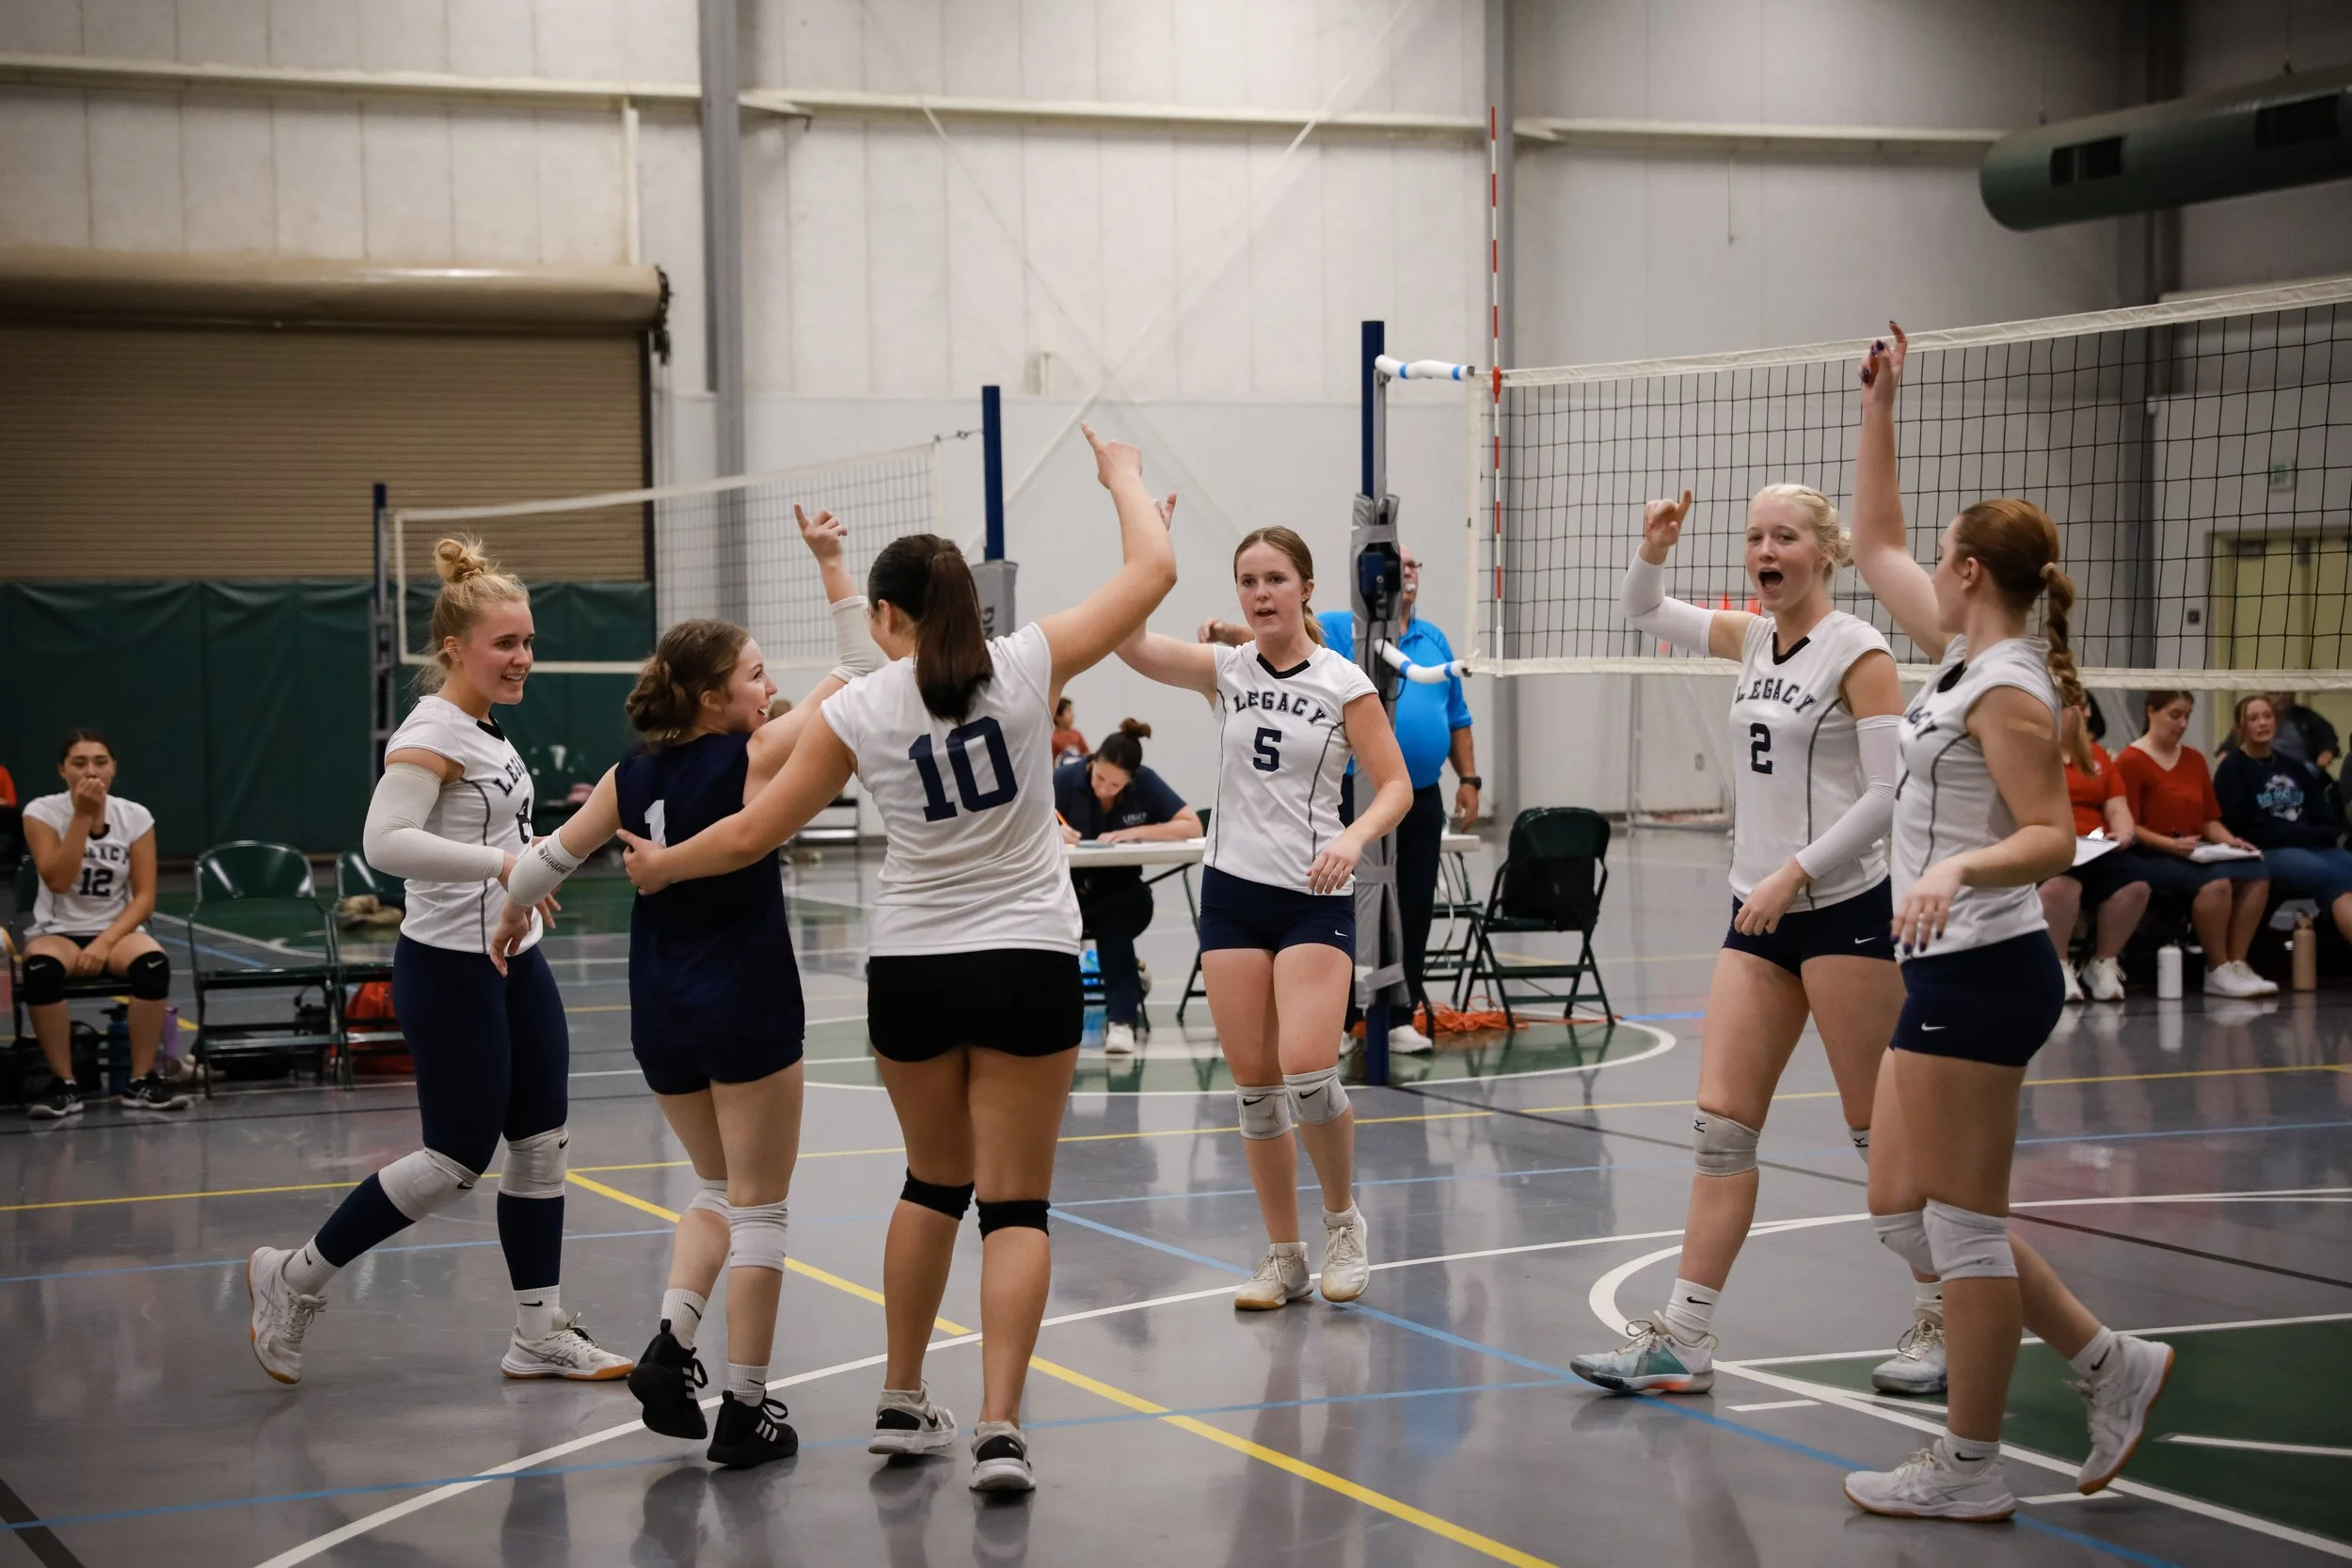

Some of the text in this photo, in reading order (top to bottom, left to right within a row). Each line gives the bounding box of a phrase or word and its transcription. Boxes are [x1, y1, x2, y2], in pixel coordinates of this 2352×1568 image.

[1232, 689, 1327, 726] LEGACY
[1735, 677, 1817, 715] LEGACY
[908, 716, 1018, 822] 10
[1252, 726, 1282, 772] 5
[1750, 722, 1773, 775] 2
[644, 799, 667, 848] 1
[79, 867, 114, 896] 12
